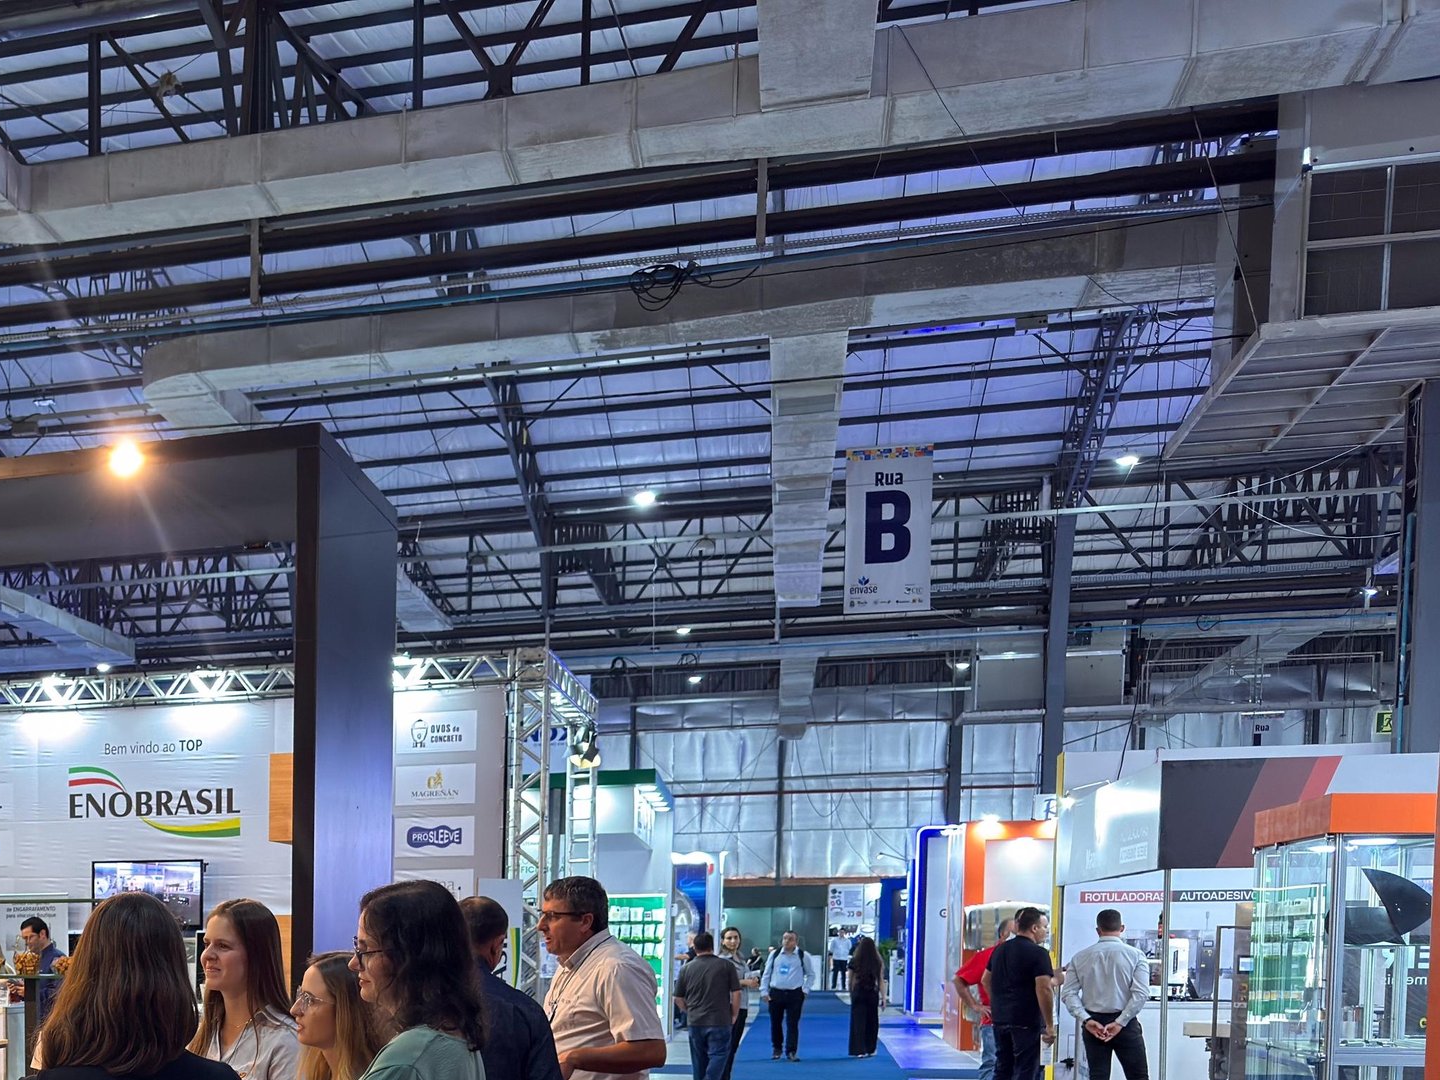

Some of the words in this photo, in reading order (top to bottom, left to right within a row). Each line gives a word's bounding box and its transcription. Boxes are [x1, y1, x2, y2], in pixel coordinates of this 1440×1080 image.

[875, 471, 904, 487] Rua
[864, 489, 912, 565] B
[849, 585, 878, 595] envase
[431, 724, 451, 733] OVOS
[1255, 724, 1270, 732] Rua
[431, 734, 463, 743] CONCRETO
[104, 743, 127, 755] Bem
[130, 741, 160, 754] vindo
[162, 743, 176, 752] ao
[179, 739, 203, 752] TOP
[68, 787, 241, 819] ENOBRASIL
[1085, 892, 1164, 902] ROTULADORAS
